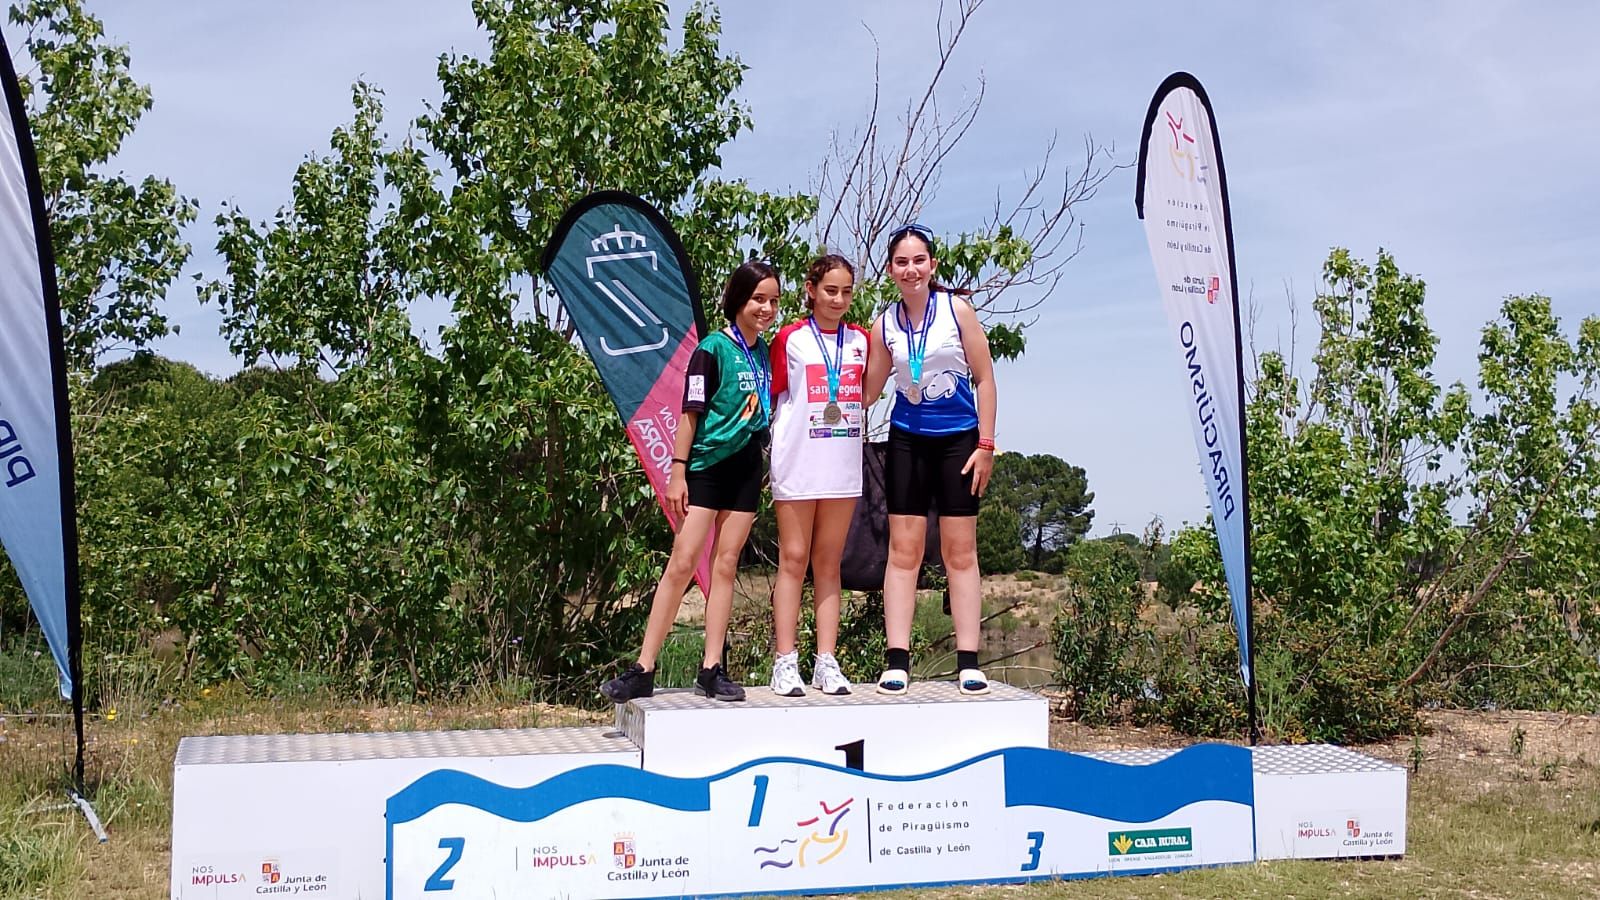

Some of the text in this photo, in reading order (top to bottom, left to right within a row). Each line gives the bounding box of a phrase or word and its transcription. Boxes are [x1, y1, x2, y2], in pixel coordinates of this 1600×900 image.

[748, 775, 769, 827] 1
[877, 799, 968, 811] Federación
[878, 821, 970, 833] de Piragüismo
[1363, 831, 1383, 839] Junta
[1134, 836, 1189, 848] CAJA RURAL
[1342, 837, 1393, 847] Castilla y León
[533, 845, 558, 855] NOS
[879, 843, 971, 856] de Castilla y León
[1020, 831, 1045, 872] 3
[423, 837, 466, 891] 2
[639, 855, 689, 867] Junta de
[192, 866, 214, 874] NOS
[607, 867, 690, 881] Castilla y León
[284, 874, 327, 884] Junta de
[256, 883, 327, 894] Castilla y León
